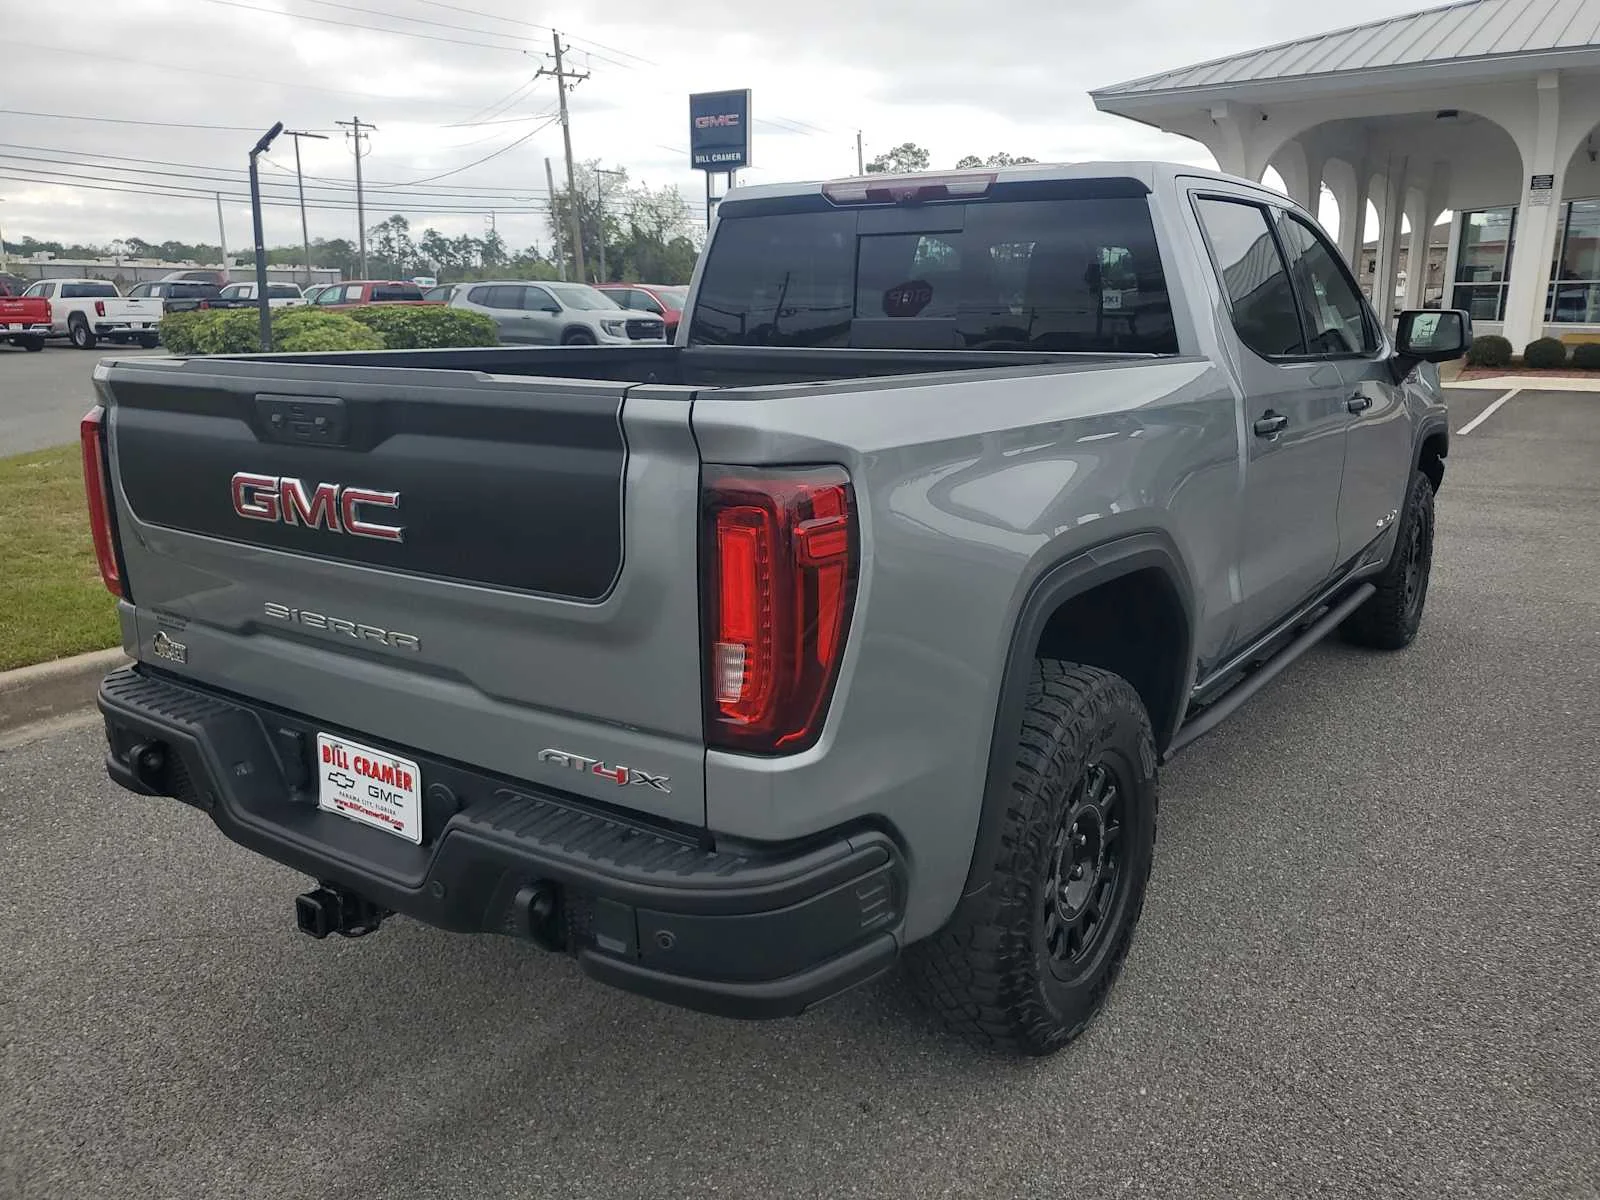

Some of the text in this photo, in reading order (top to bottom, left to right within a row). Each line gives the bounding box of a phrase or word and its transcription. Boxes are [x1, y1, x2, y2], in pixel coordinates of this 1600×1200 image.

[695, 114, 740, 128] GMC
[695, 152, 741, 163] BILL CRAMER
[231, 471, 405, 543] GMC
[264, 601, 421, 651] SIERRA
[322, 743, 413, 793] BILL CRAMER
[537, 748, 672, 794] AT4X
[339, 790, 360, 802] PANAMA
[368, 785, 404, 808] GMC
